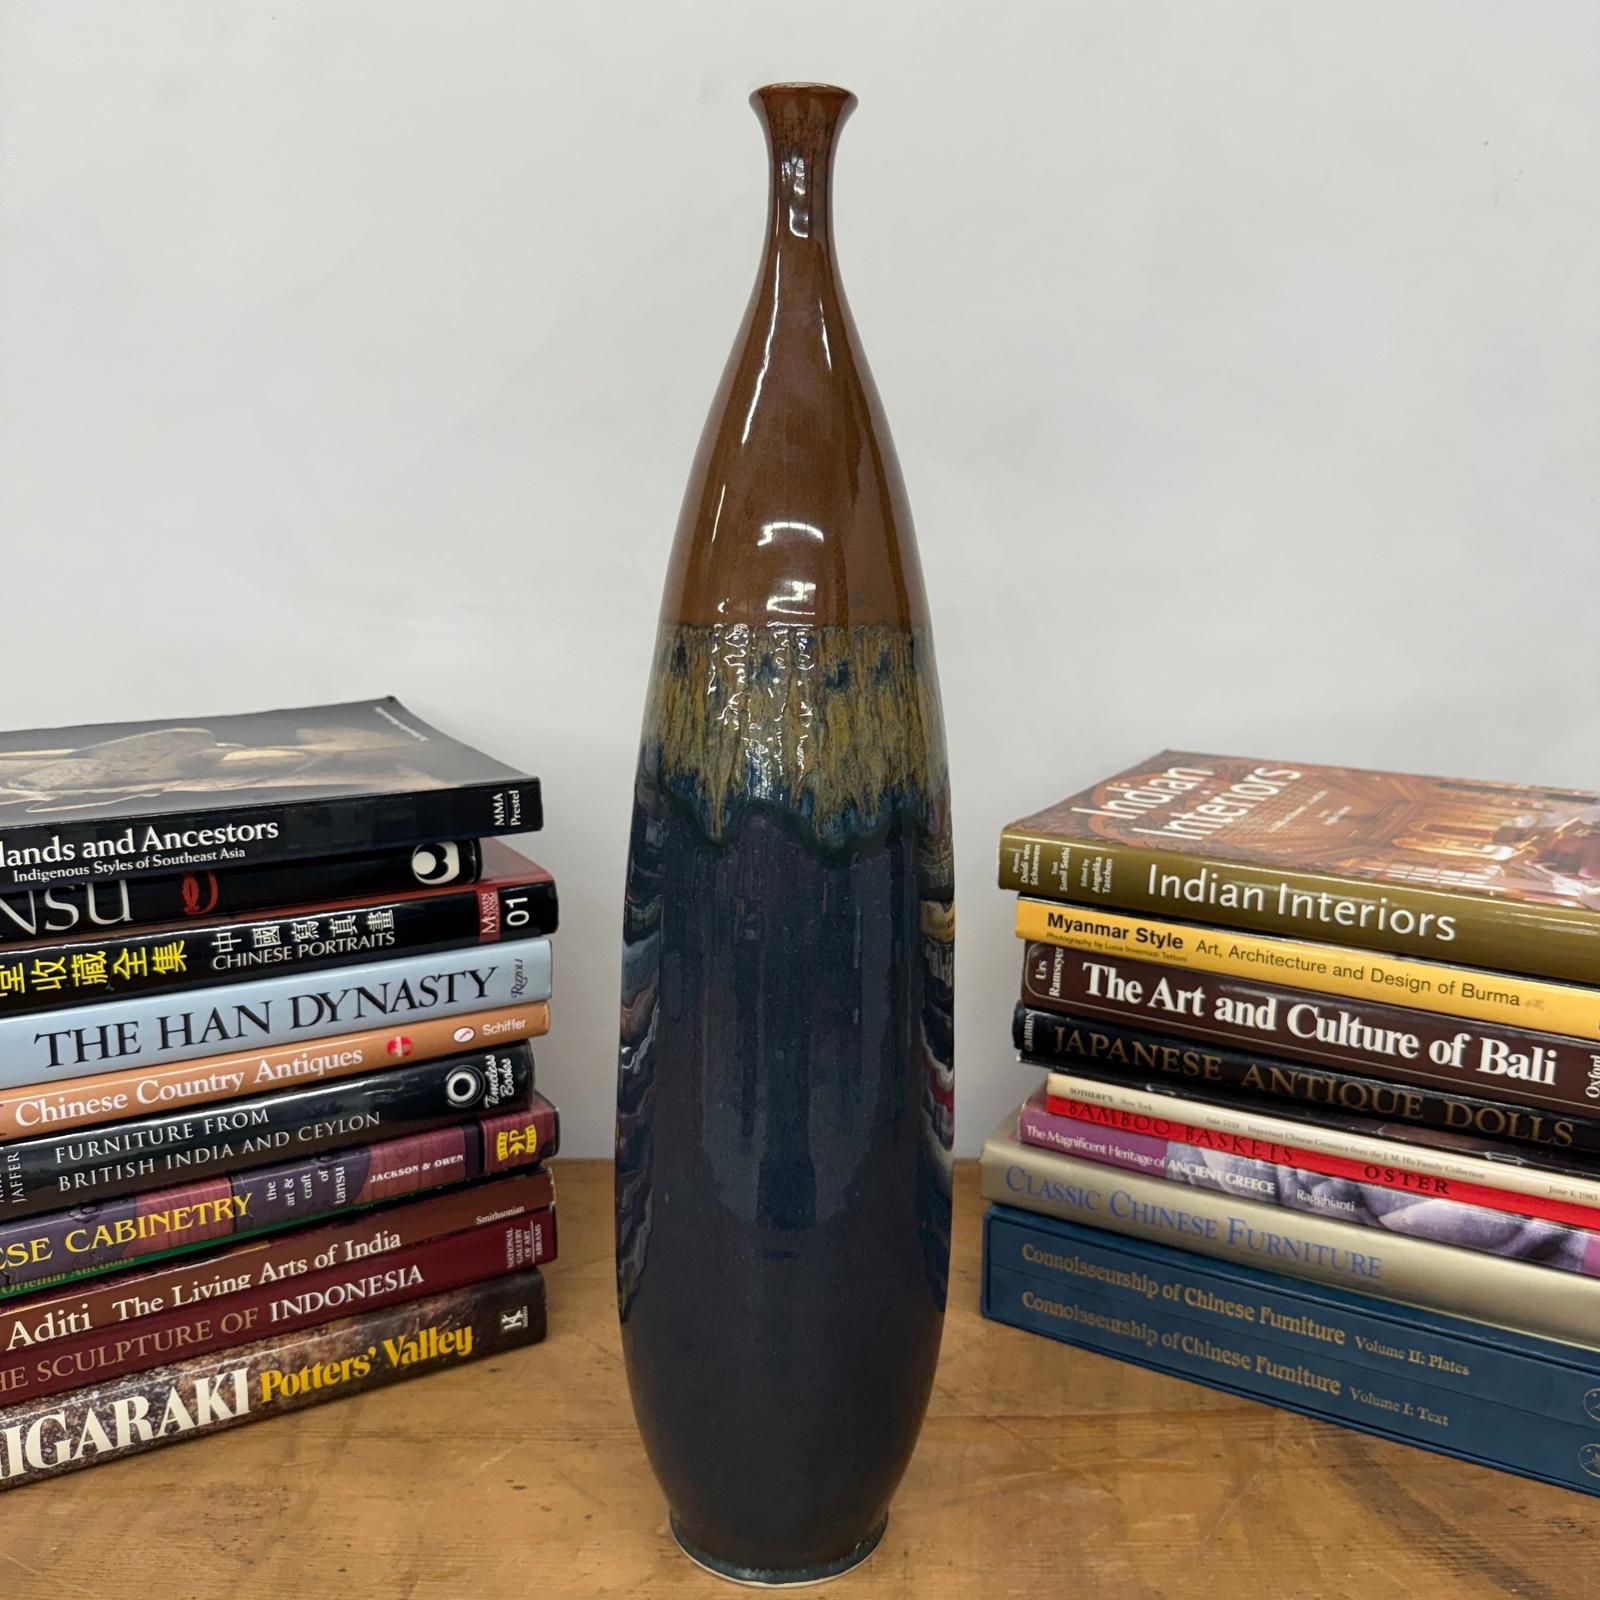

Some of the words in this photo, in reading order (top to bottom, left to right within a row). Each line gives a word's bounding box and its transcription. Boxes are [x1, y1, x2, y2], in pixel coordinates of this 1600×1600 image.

[494, 793, 505, 826] MMA
[509, 790, 521, 826] Prestel
[1070, 766, 1215, 820] Indian
[1130, 767, 1303, 841] Interiors
[13, 866, 90, 883] Indigenous
[94, 859, 133, 876] Styles
[136, 857, 150, 870] of
[153, 851, 218, 868] Southeast
[220, 847, 246, 860] Asia
[83, 828, 136, 858] and
[141, 821, 279, 852] Ancestors
[505, 897, 530, 926] 01
[1148, 864, 1265, 912] Indian
[1278, 882, 1456, 941] Interiors
[212, 945, 293, 971] CHINESE
[299, 931, 396, 960] PORTRAITS
[1035, 960, 1048, 981] Urs
[1047, 912, 1129, 940] Myanmar
[1135, 927, 1184, 949] Style
[1195, 939, 1223, 958] Art,
[1228, 944, 1327, 974] Architecture
[1332, 963, 1364, 981] and
[1370, 967, 1432, 993] Design
[1437, 980, 1455, 995] of
[1461, 983, 1520, 1007] Burma
[34, 1020, 142, 1068] THE
[156, 1000, 273, 1050] HAN
[288, 965, 499, 1030] DYNASTY
[483, 1018, 527, 1036] Schiffer
[1082, 961, 1144, 1005] The
[1147, 976, 1205, 1018] Art
[1214, 994, 1277, 1031] and
[1287, 1002, 1420, 1061] Culture
[1428, 1033, 1471, 1068] of
[1475, 1036, 1557, 1087] Bali
[15, 1092, 129, 1127] Chinese
[136, 1071, 245, 1106] Country
[254, 1050, 364, 1084] Antiques
[498, 1057, 515, 1098] Books
[1053, 1025, 1223, 1081] JAPANESE
[1240, 1063, 1424, 1120] ANTIQUE
[1444, 1100, 1574, 1148] DOLLS
[55, 1122, 195, 1165] FURNITURE
[204, 1107, 270, 1135] FROM
[58, 1159, 155, 1192] BRITISH
[166, 1144, 235, 1170] INDIA
[242, 1131, 290, 1155] AND
[298, 1111, 381, 1141] CEYLON
[1068, 1099, 1171, 1135] BAMBOO
[1185, 1124, 1292, 1162] BASKETS
[1363, 1165, 1449, 1194] OSTER
[7, 1151, 28, 1203] JAFFER
[267, 1181, 277, 1201] the
[301, 1173, 312, 1199] craft
[318, 1170, 329, 1182] of
[369, 1165, 420, 1184] JACKSON
[421, 1161, 432, 1171] &
[434, 1154, 465, 1168] OWEN
[1026, 1124, 1046, 1140] The
[1047, 1130, 1107, 1155] Magnificent
[1109, 1144, 1152, 1167] Heritage
[1153, 1157, 1167, 1168] of
[1167, 1159, 1223, 1182] ANCIENT
[1225, 1174, 1275, 1195] GREECE
[1296, 1185, 1355, 1213] Ragghianti
[64, 1192, 252, 1253] CABINETRY
[286, 1191, 295, 1206] art
[475, 1205, 525, 1225] Smithsonian
[1005, 1165, 1100, 1211] CLASSIC
[1109, 1190, 1218, 1239] CHINESE
[1227, 1216, 1382, 1280] FURNITURE
[5, 1303, 94, 1351] Aditi
[112, 1295, 164, 1322] The
[171, 1274, 251, 1308] Living
[258, 1257, 308, 1285] Arts
[314, 1244, 338, 1270] of
[345, 1229, 402, 1262] India
[1021, 1243, 1158, 1299] Connoisseurship
[1162, 1284, 1182, 1301] of
[1184, 1287, 1255, 1322] Chinese
[1259, 1305, 1345, 1346] Furniture
[1354, 1335, 1405, 1361] Volume
[1427, 1353, 1470, 1377] Plates
[37, 1320, 214, 1382] SCULPTURE
[220, 1307, 258, 1335] OF
[270, 1264, 425, 1323] INDONESIA
[1021, 1290, 1158, 1347] Connoisseurship
[1161, 1332, 1182, 1349] of
[1181, 1335, 1252, 1370] Chinese
[1255, 1355, 1341, 1395] Furniture
[1350, 1387, 1399, 1413] Volume
[1416, 1406, 1449, 1427] Text
[0, 1367, 251, 1480] IGARAKI
[382, 1326, 473, 1369] Valley
